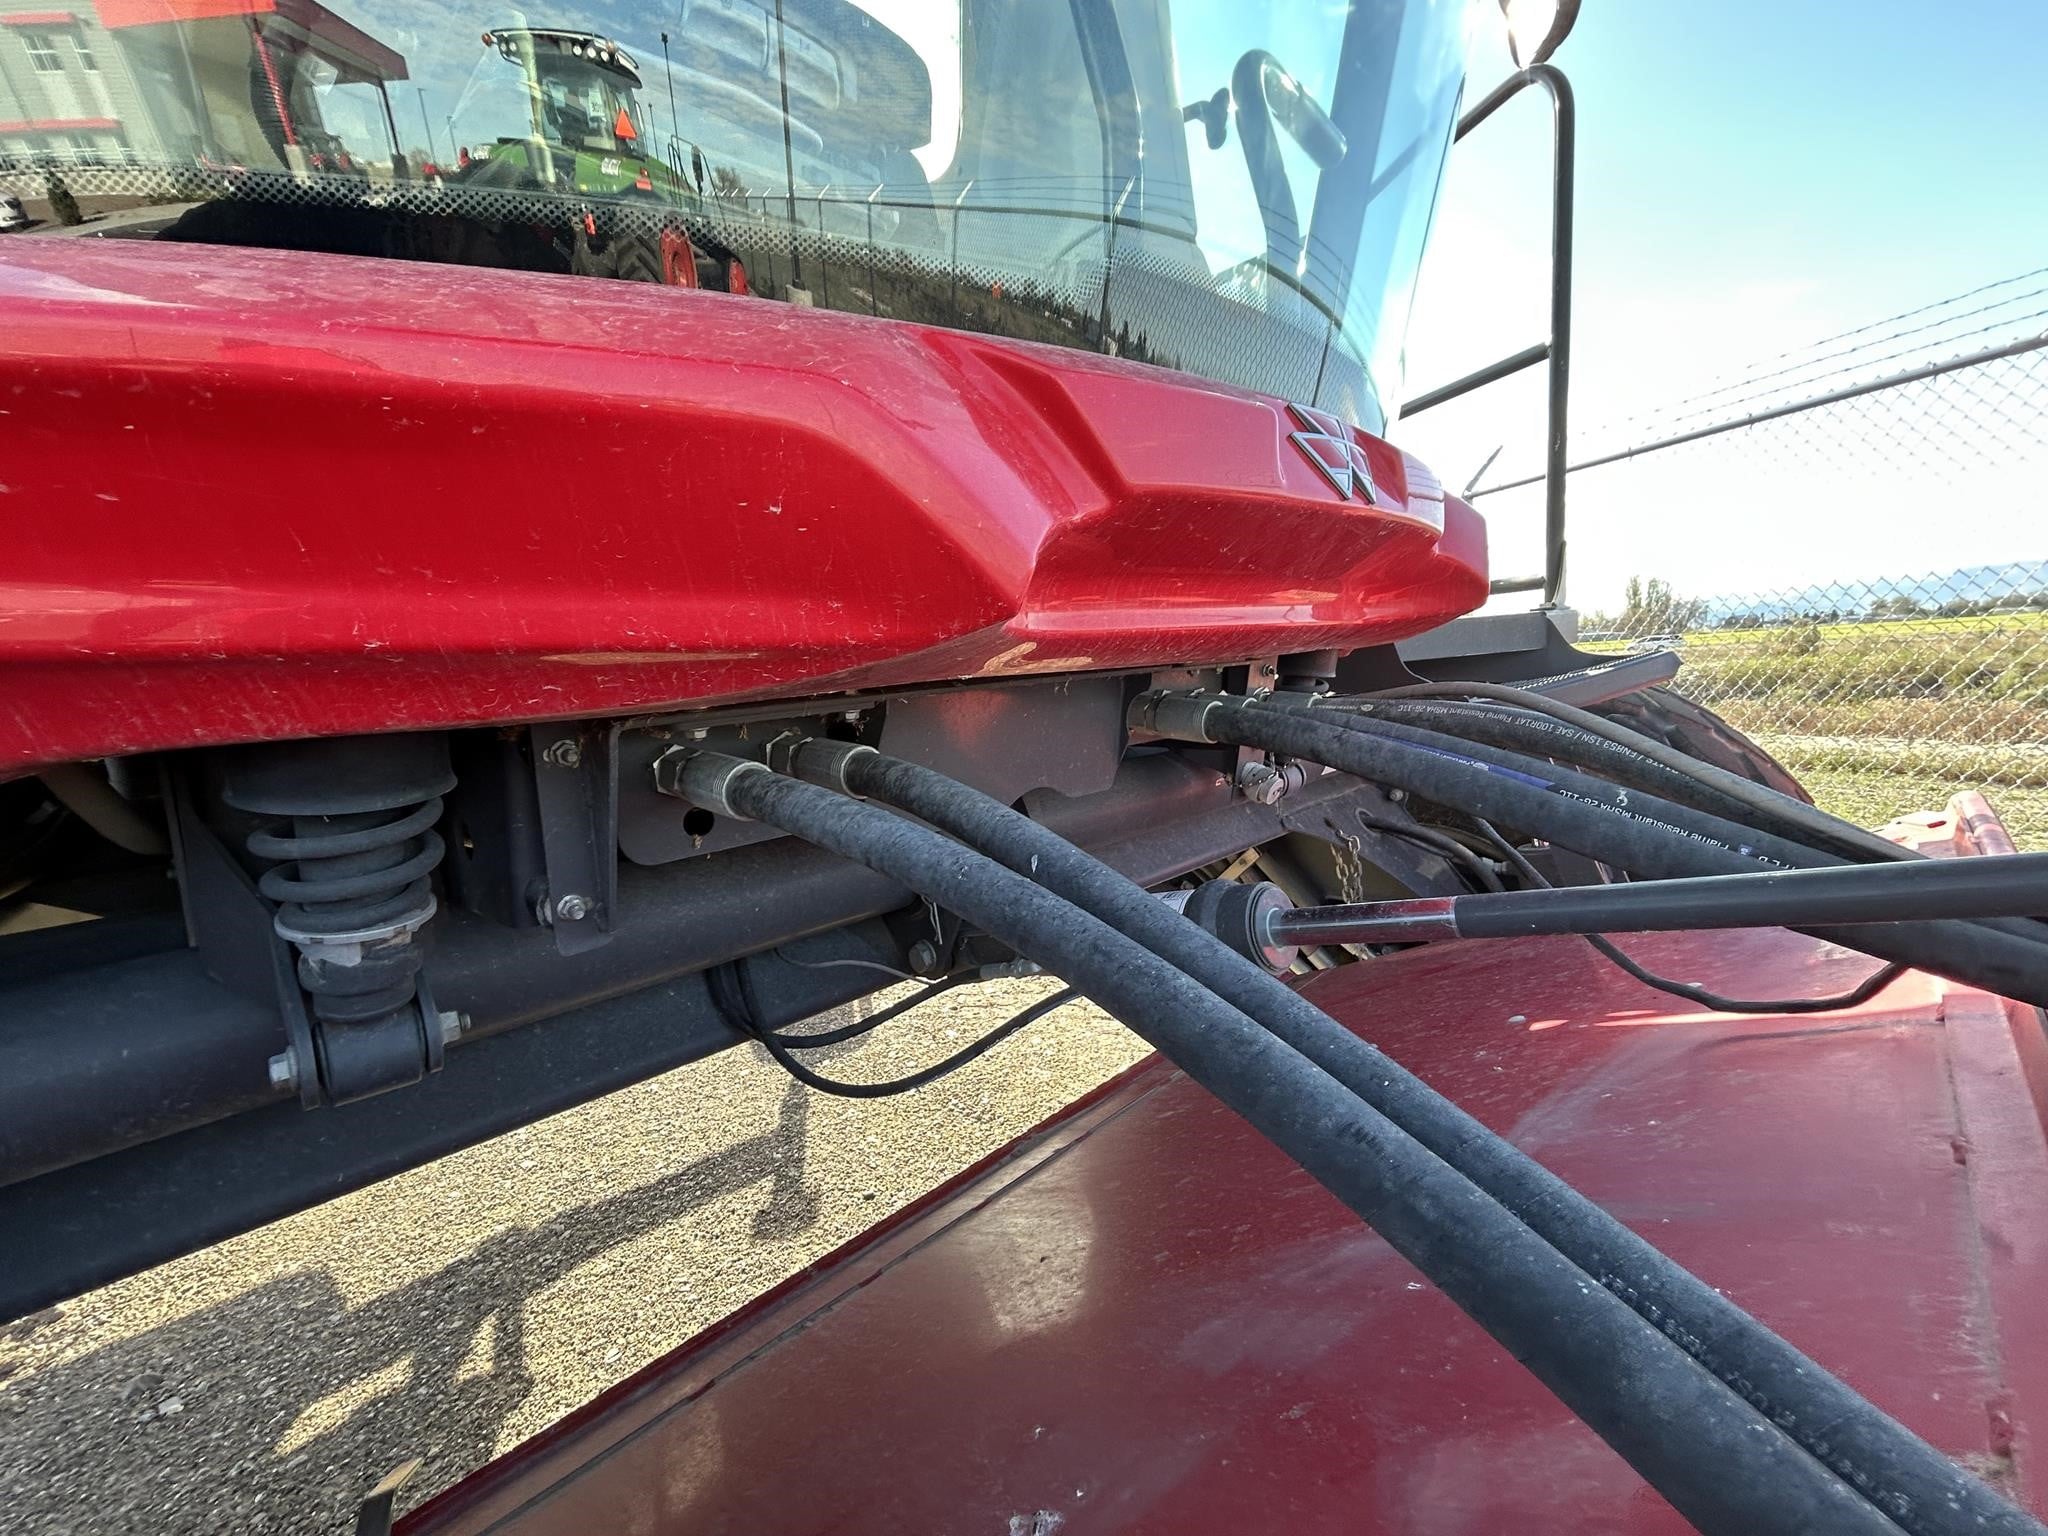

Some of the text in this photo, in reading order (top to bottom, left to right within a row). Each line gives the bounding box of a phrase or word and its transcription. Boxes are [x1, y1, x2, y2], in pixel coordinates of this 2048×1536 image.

[1425, 705, 1449, 715] MSHA
[1449, 706, 1487, 719] Resistant
[1486, 712, 1513, 724] Flame
[1514, 716, 1556, 732] 100R1AT
[1555, 725, 1576, 738] SAE
[1581, 733, 1602, 747] 1SN
